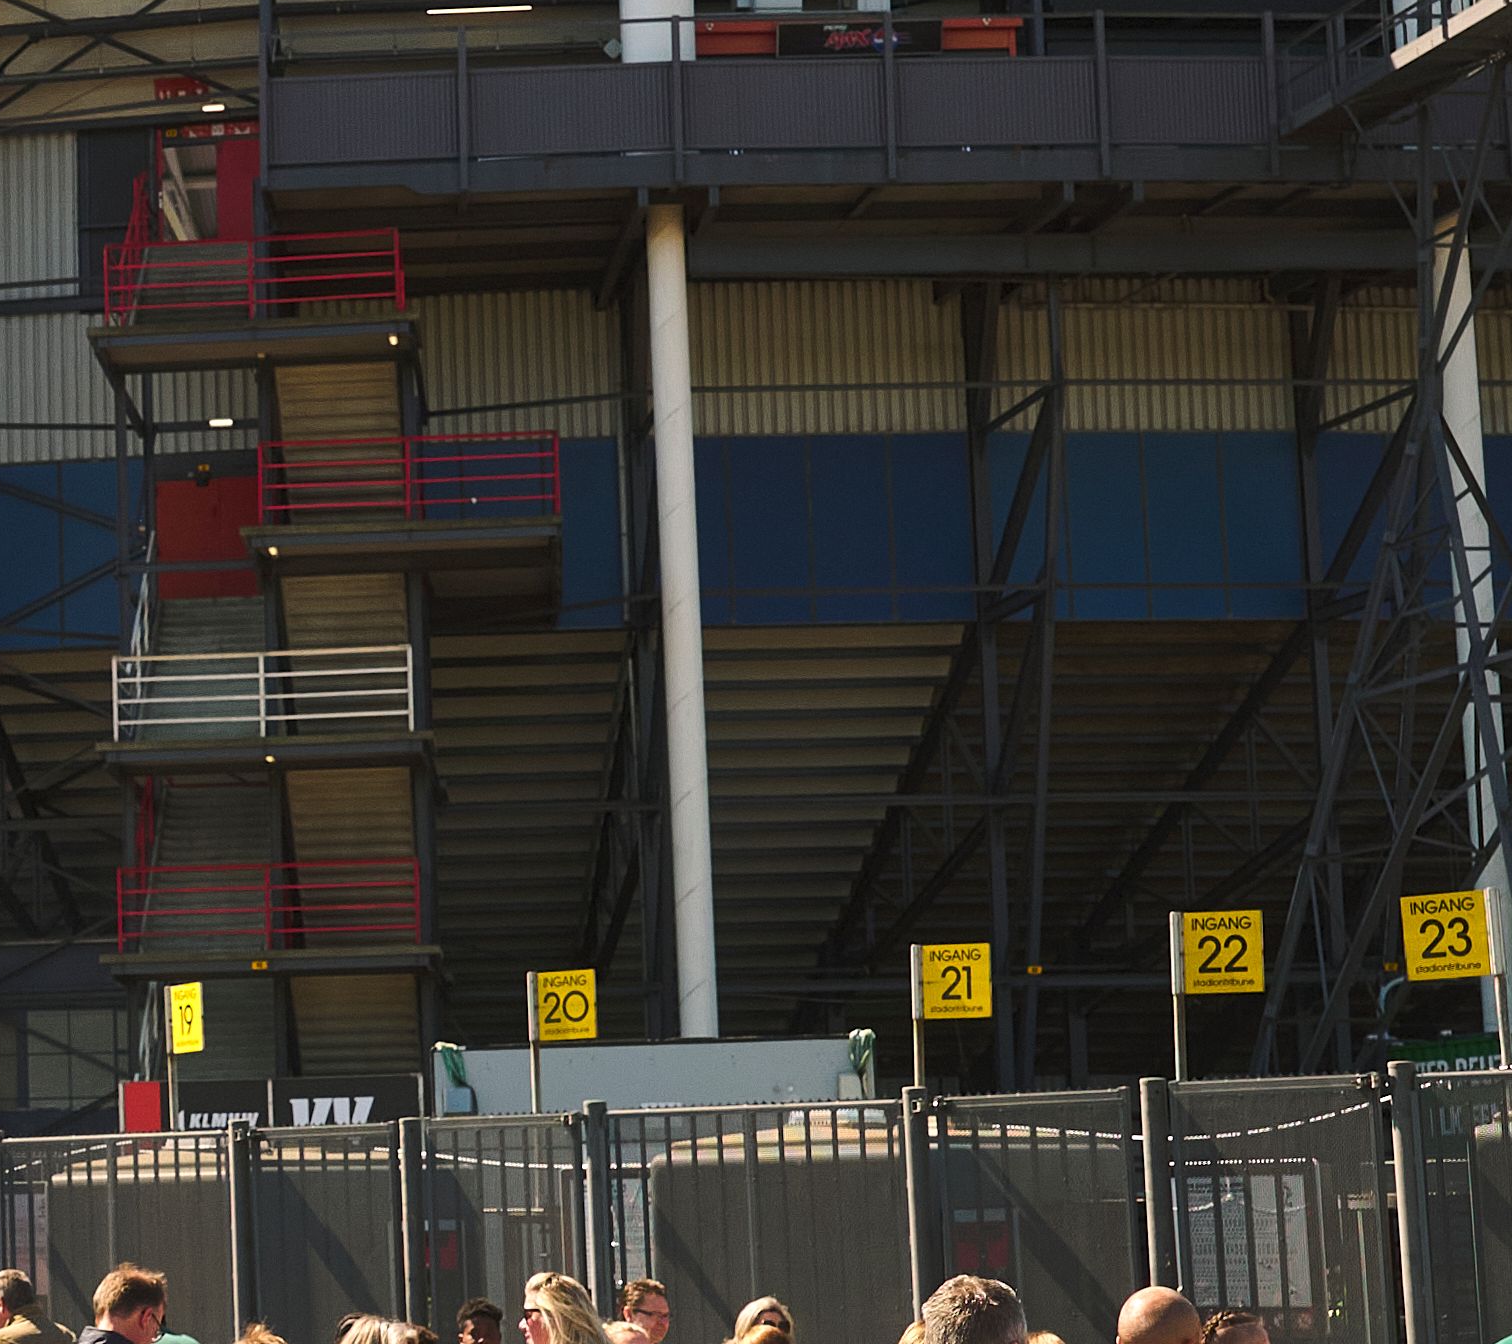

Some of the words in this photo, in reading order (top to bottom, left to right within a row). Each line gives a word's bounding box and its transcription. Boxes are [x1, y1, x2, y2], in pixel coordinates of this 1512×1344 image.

[1410, 897, 1474, 915] INGANG
[1191, 916, 1252, 931] INGANG
[1419, 917, 1472, 959] 23
[929, 949, 981, 962] INGANG
[1198, 935, 1248, 973] 22
[1416, 962, 1481, 974] stadiontribune
[543, 976, 587, 988] INGANG
[941, 966, 972, 1000] 21
[1194, 978, 1255, 988] stadiontribune
[543, 990, 589, 1024] 20
[930, 1005, 983, 1014] stadiontribune
[179, 1004, 194, 1036] 19
